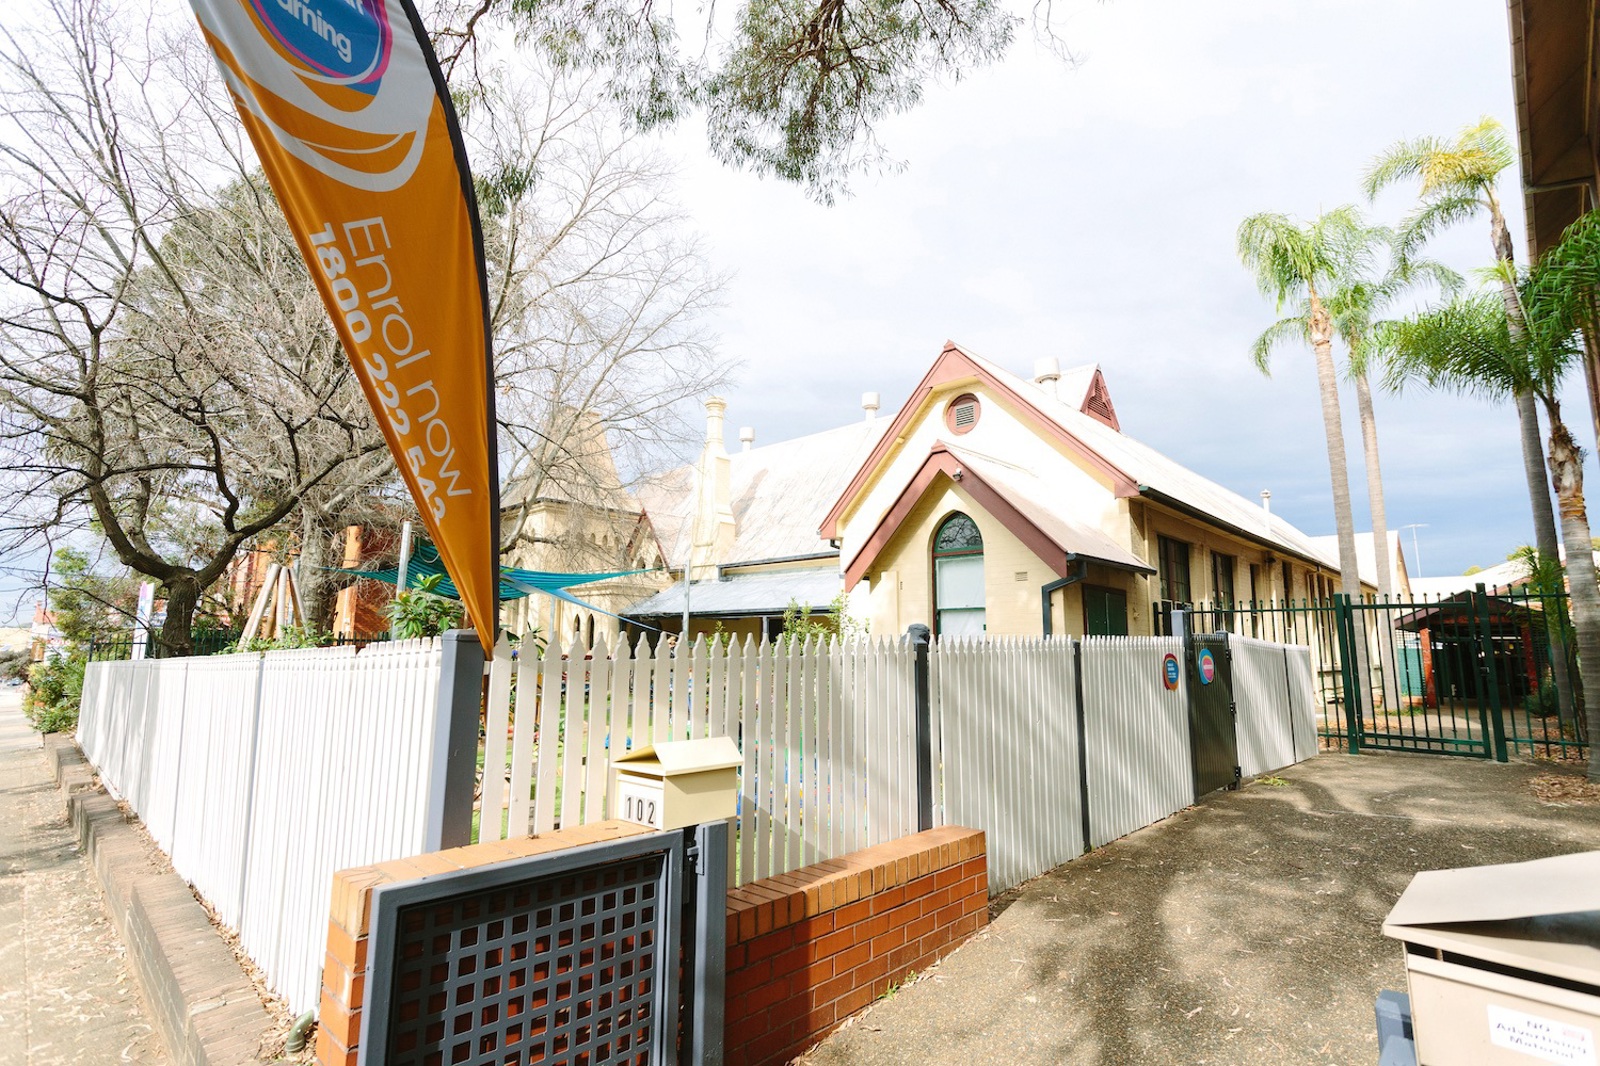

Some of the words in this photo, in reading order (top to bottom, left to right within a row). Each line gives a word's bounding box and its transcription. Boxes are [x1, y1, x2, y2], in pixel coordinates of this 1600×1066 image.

[309, 222, 372, 344] 1800
[363, 352, 411, 436] 222
[343, 216, 431, 369] Enrol
[407, 379, 472, 497] now
[626, 796, 655, 824] 102
